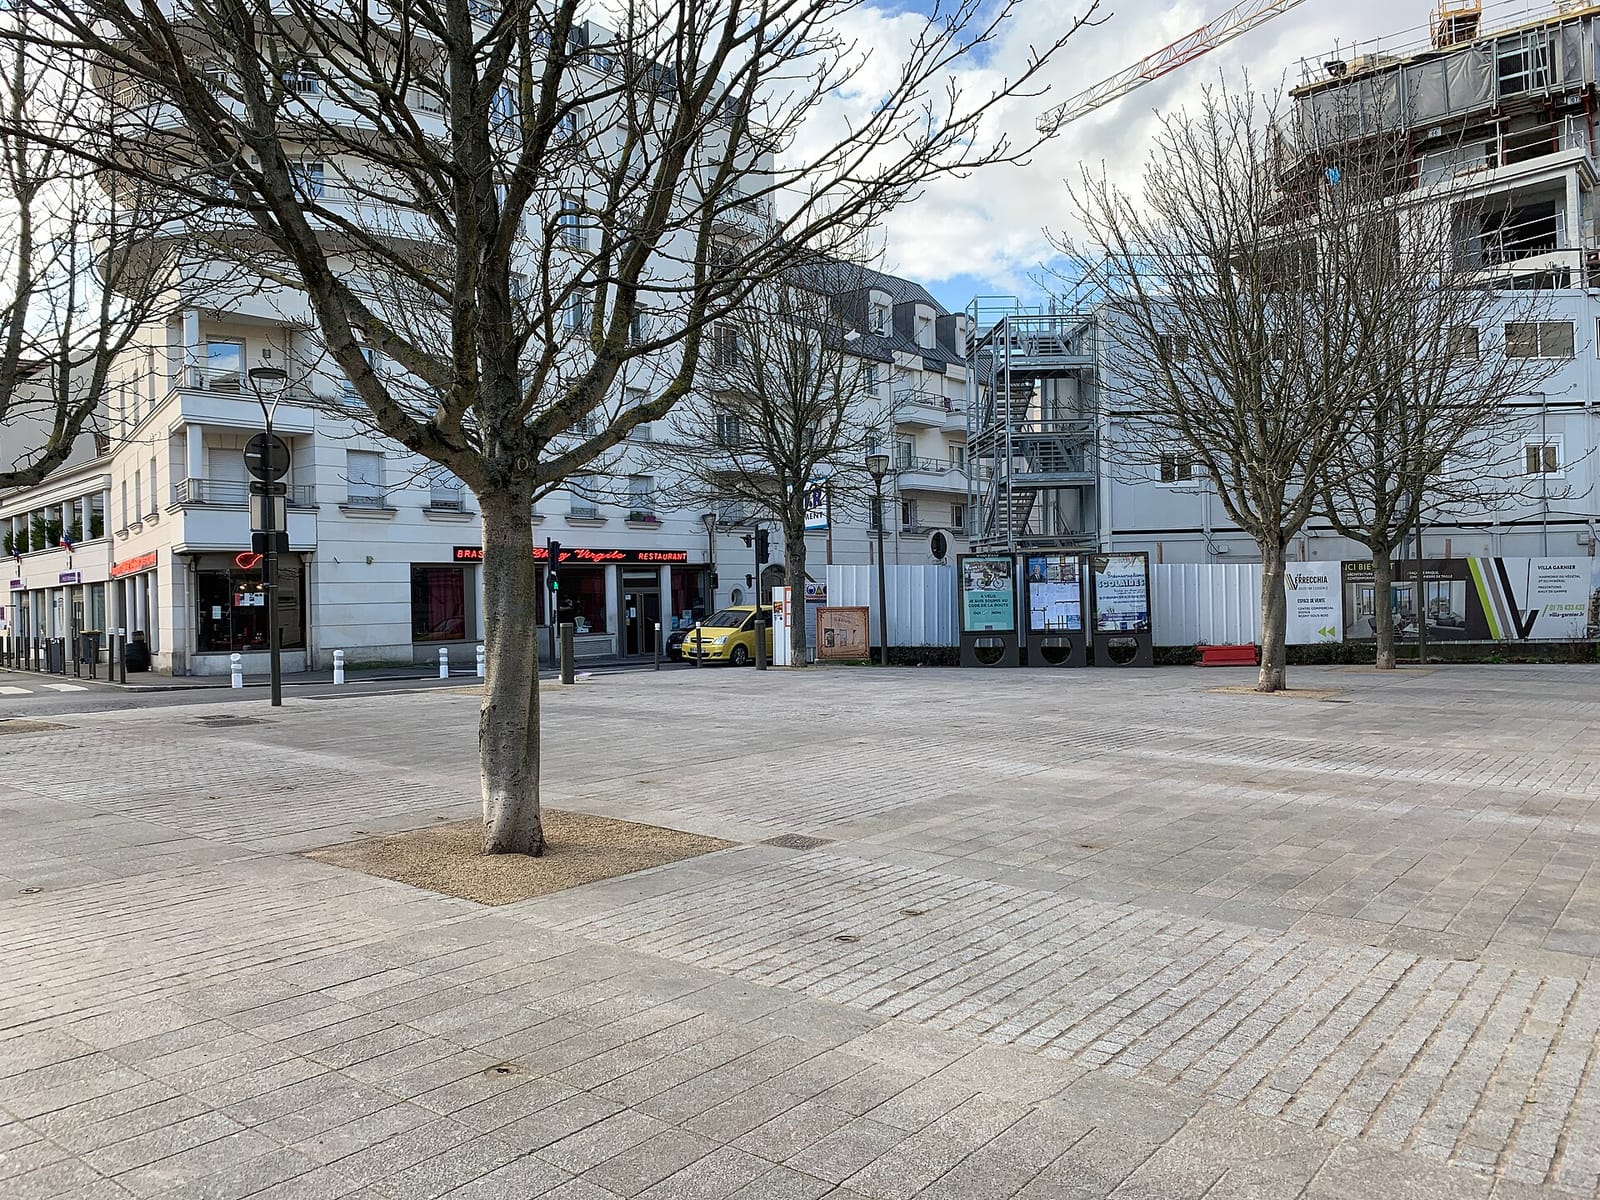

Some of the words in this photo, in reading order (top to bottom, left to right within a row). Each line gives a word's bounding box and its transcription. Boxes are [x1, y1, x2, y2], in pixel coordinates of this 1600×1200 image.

[638, 552, 687, 560] RESTAURANT
[1345, 563, 1356, 571] ICI
[1098, 580, 1145, 588] SCOLAIRES
